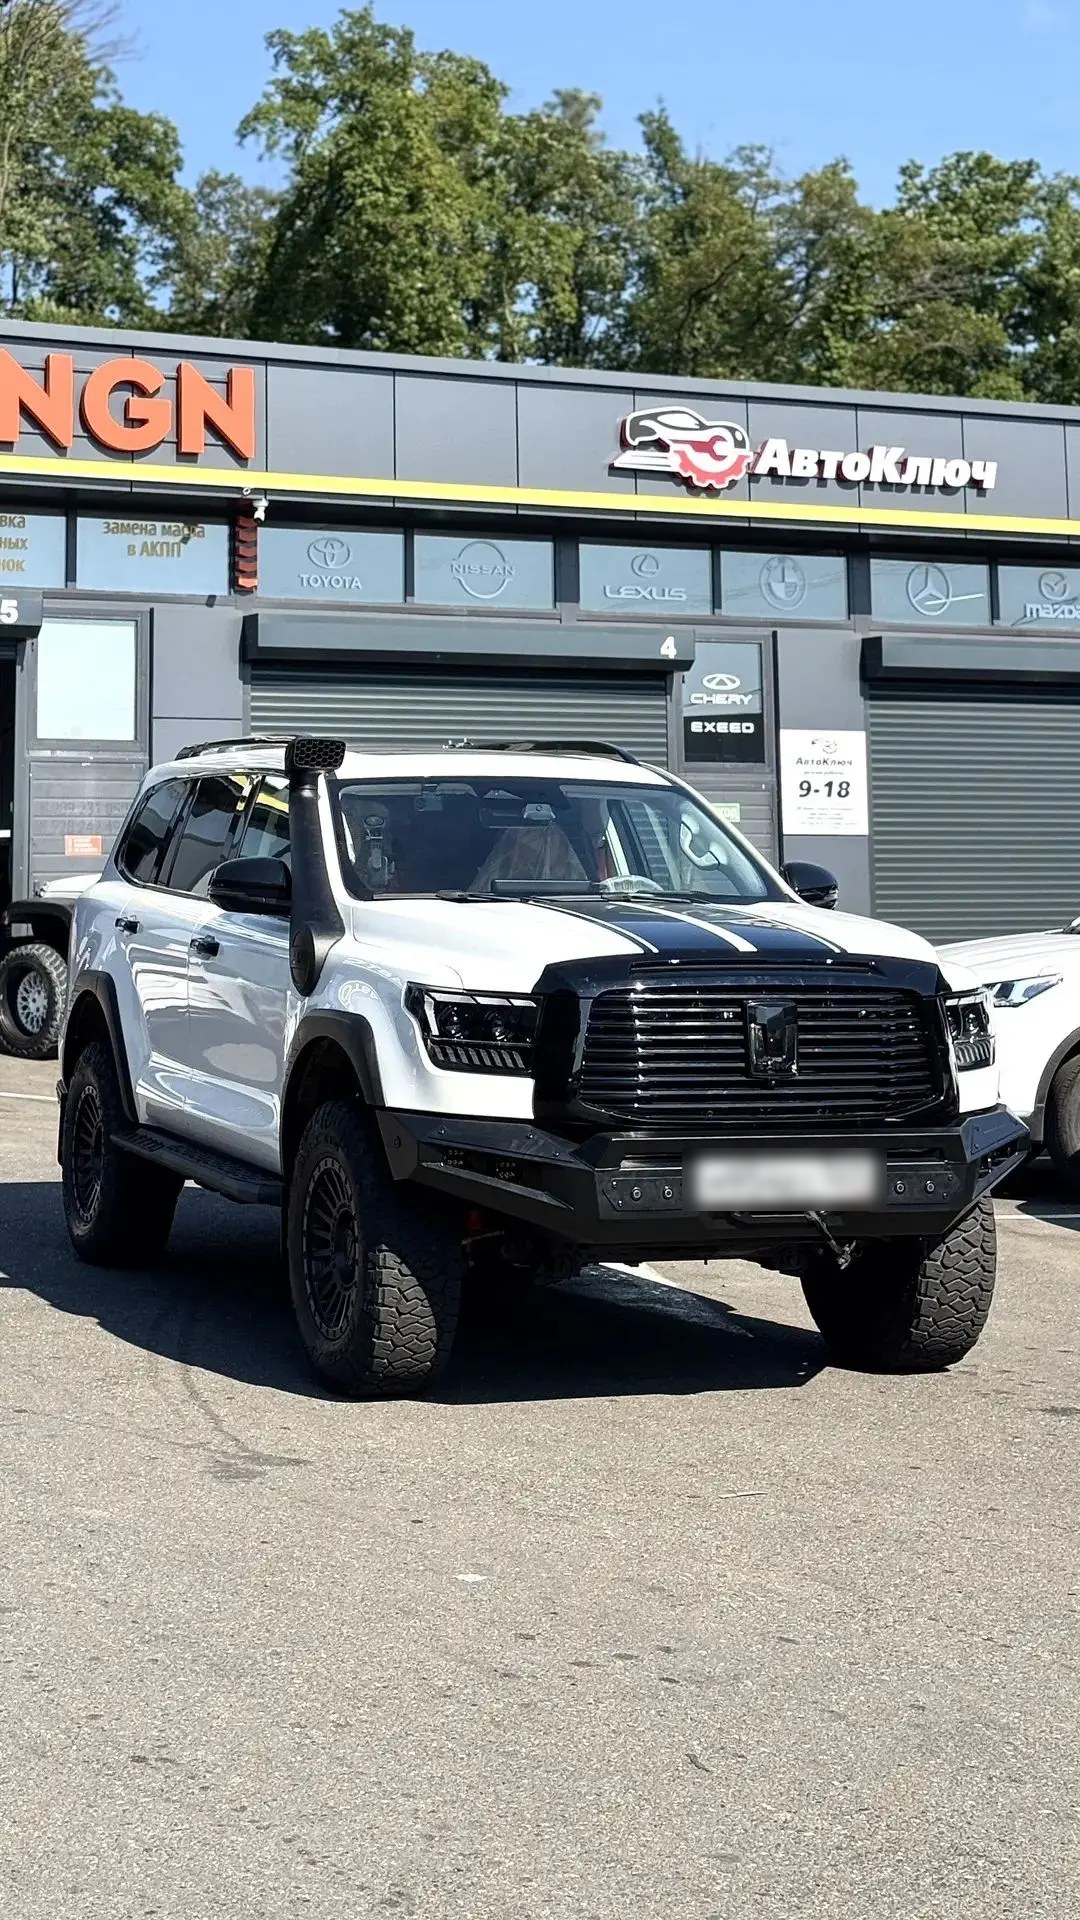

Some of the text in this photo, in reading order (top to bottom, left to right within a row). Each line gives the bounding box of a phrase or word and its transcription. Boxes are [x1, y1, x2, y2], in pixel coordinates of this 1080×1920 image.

[0, 347, 255, 459] NGN
[752, 438, 998, 489] АвтоКлюч
[103, 521, 157, 536] замена
[140, 541, 181, 558] АКПП
[450, 562, 515, 576] NISSAN
[299, 573, 362, 590] TOYOTA
[603, 584, 687, 601] LEXUS
[0, 599, 18, 625] 5
[660, 636, 677, 659] 4
[690, 693, 753, 705] CHERY
[690, 721, 755, 734] EXEED
[799, 780, 851, 798] 9-18
